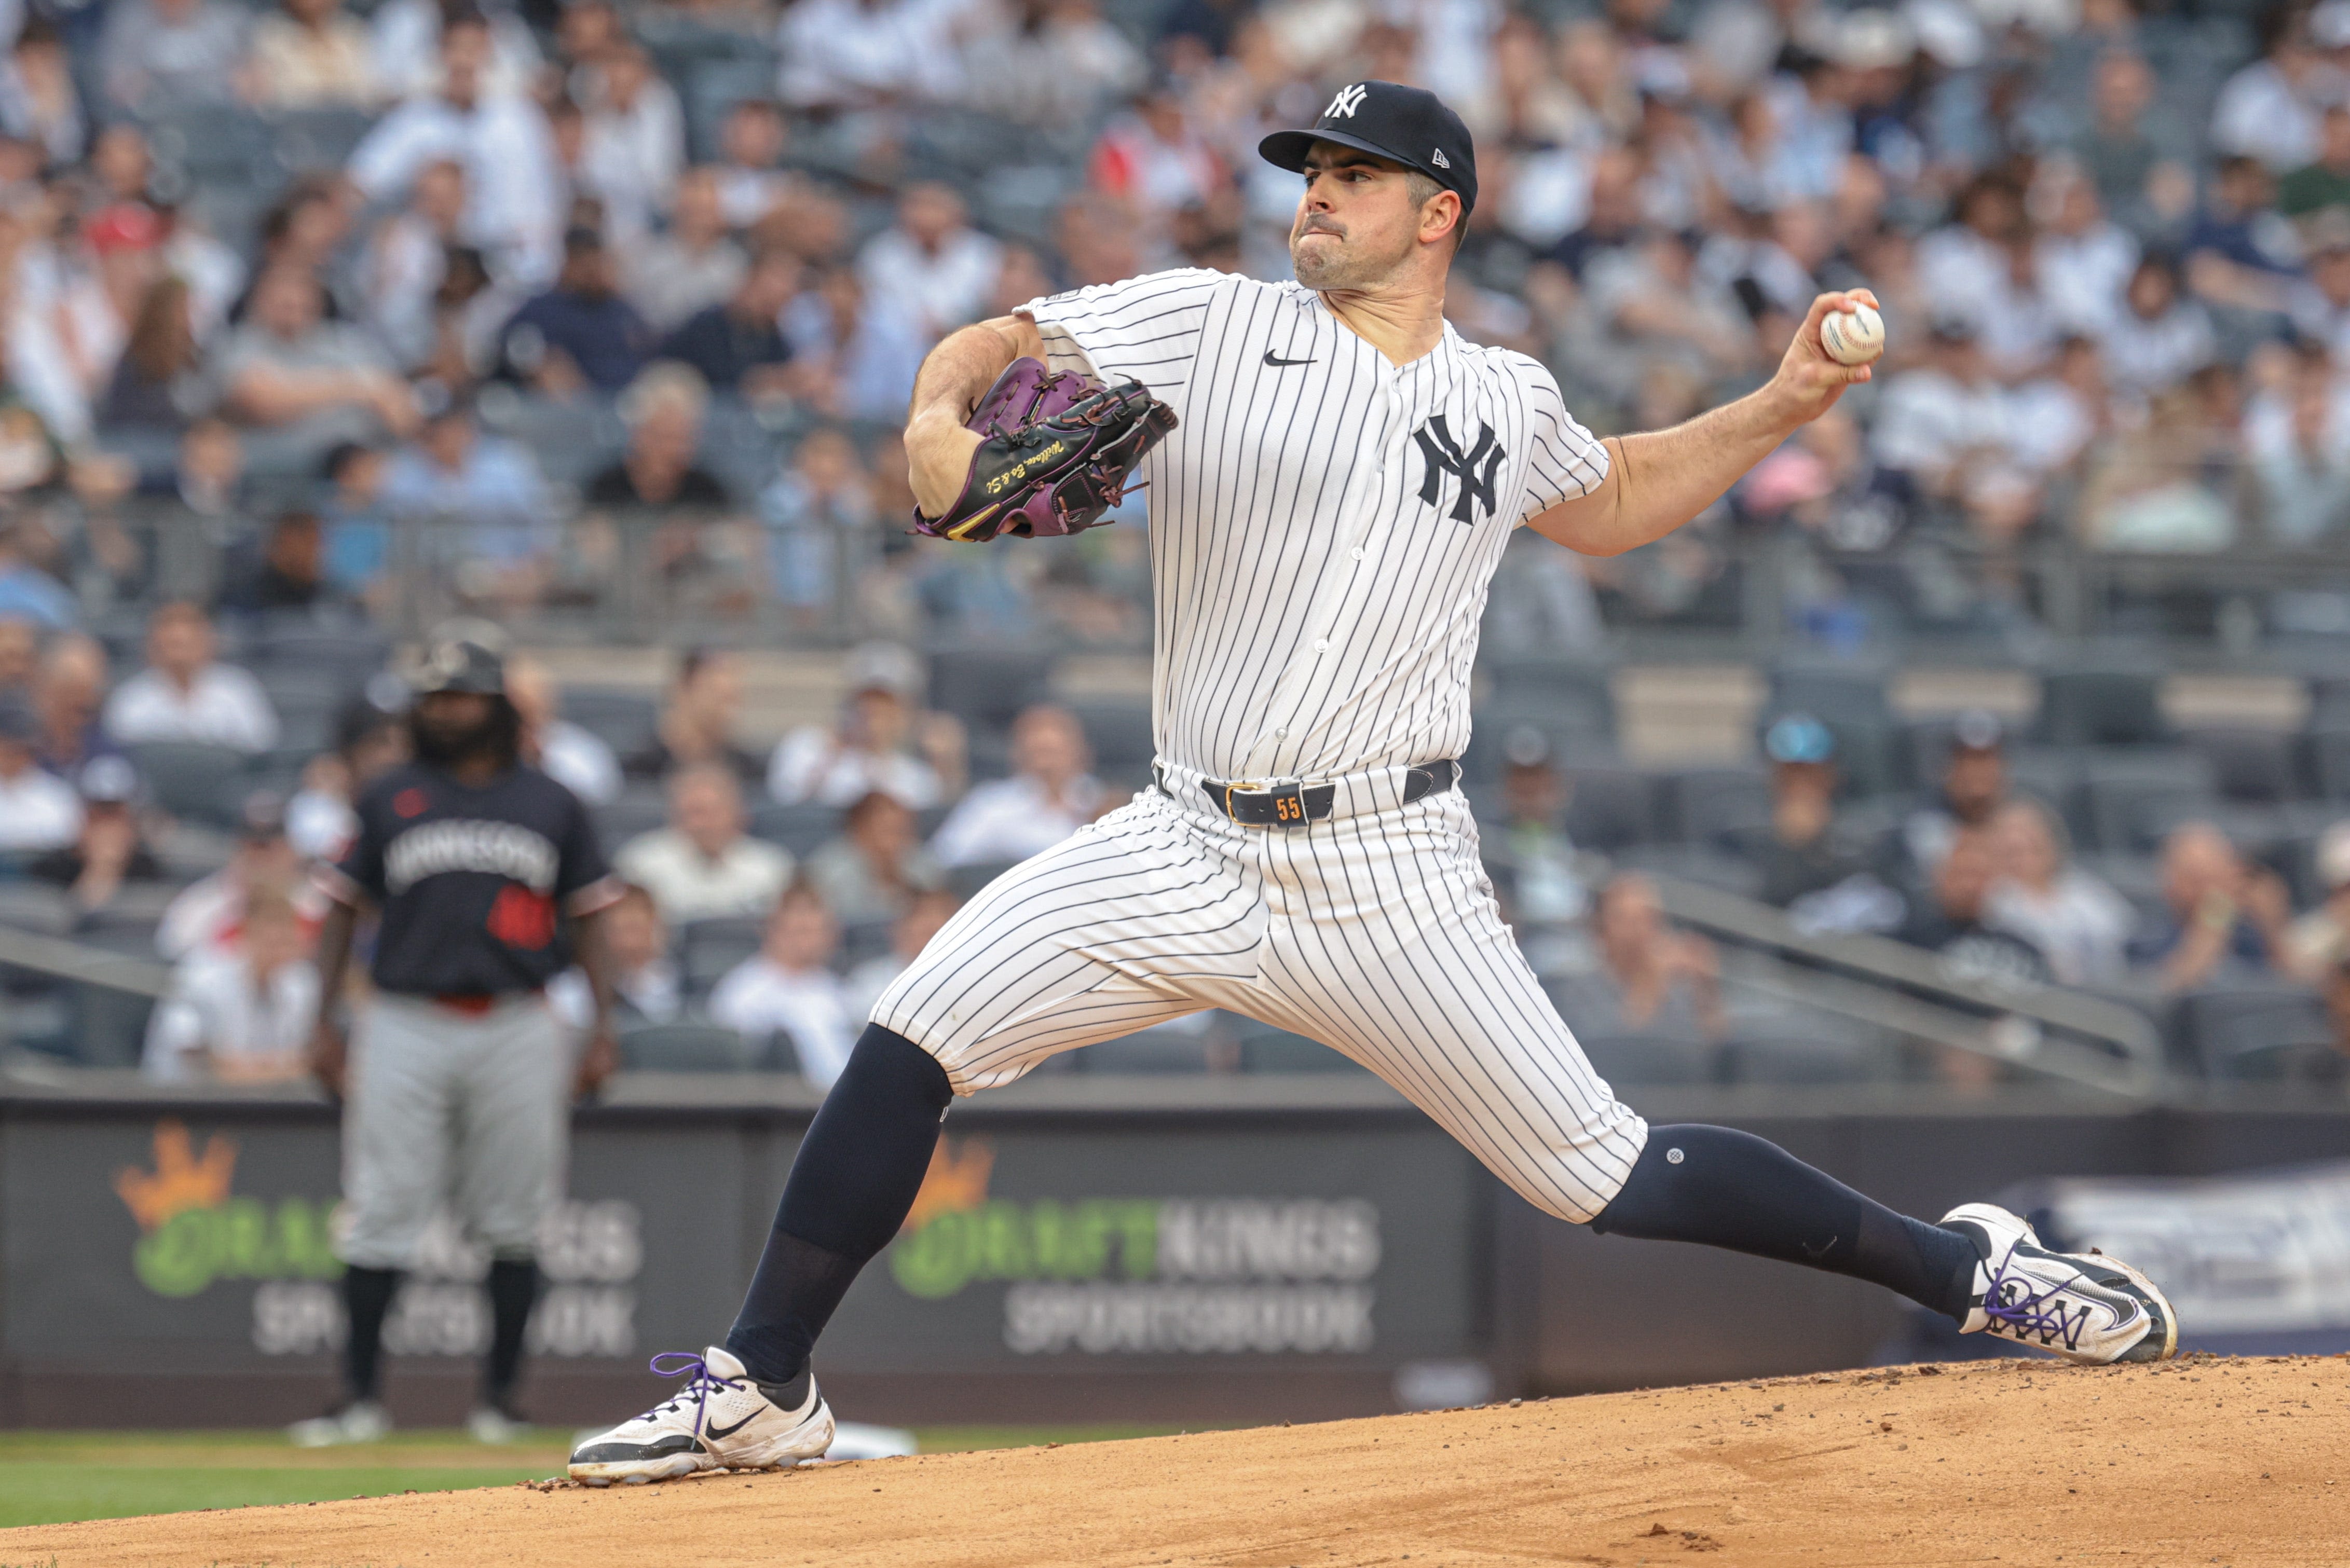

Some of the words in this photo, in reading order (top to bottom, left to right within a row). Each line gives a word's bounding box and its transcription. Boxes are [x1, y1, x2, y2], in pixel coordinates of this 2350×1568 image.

[1324, 84, 1368, 119] NY
[1001, 473, 1010, 485] &
[1010, 464, 1026, 478] Bo
[1413, 414, 1506, 526] NY
[986, 477, 1002, 494] Si
[1277, 797, 1301, 820] 55
